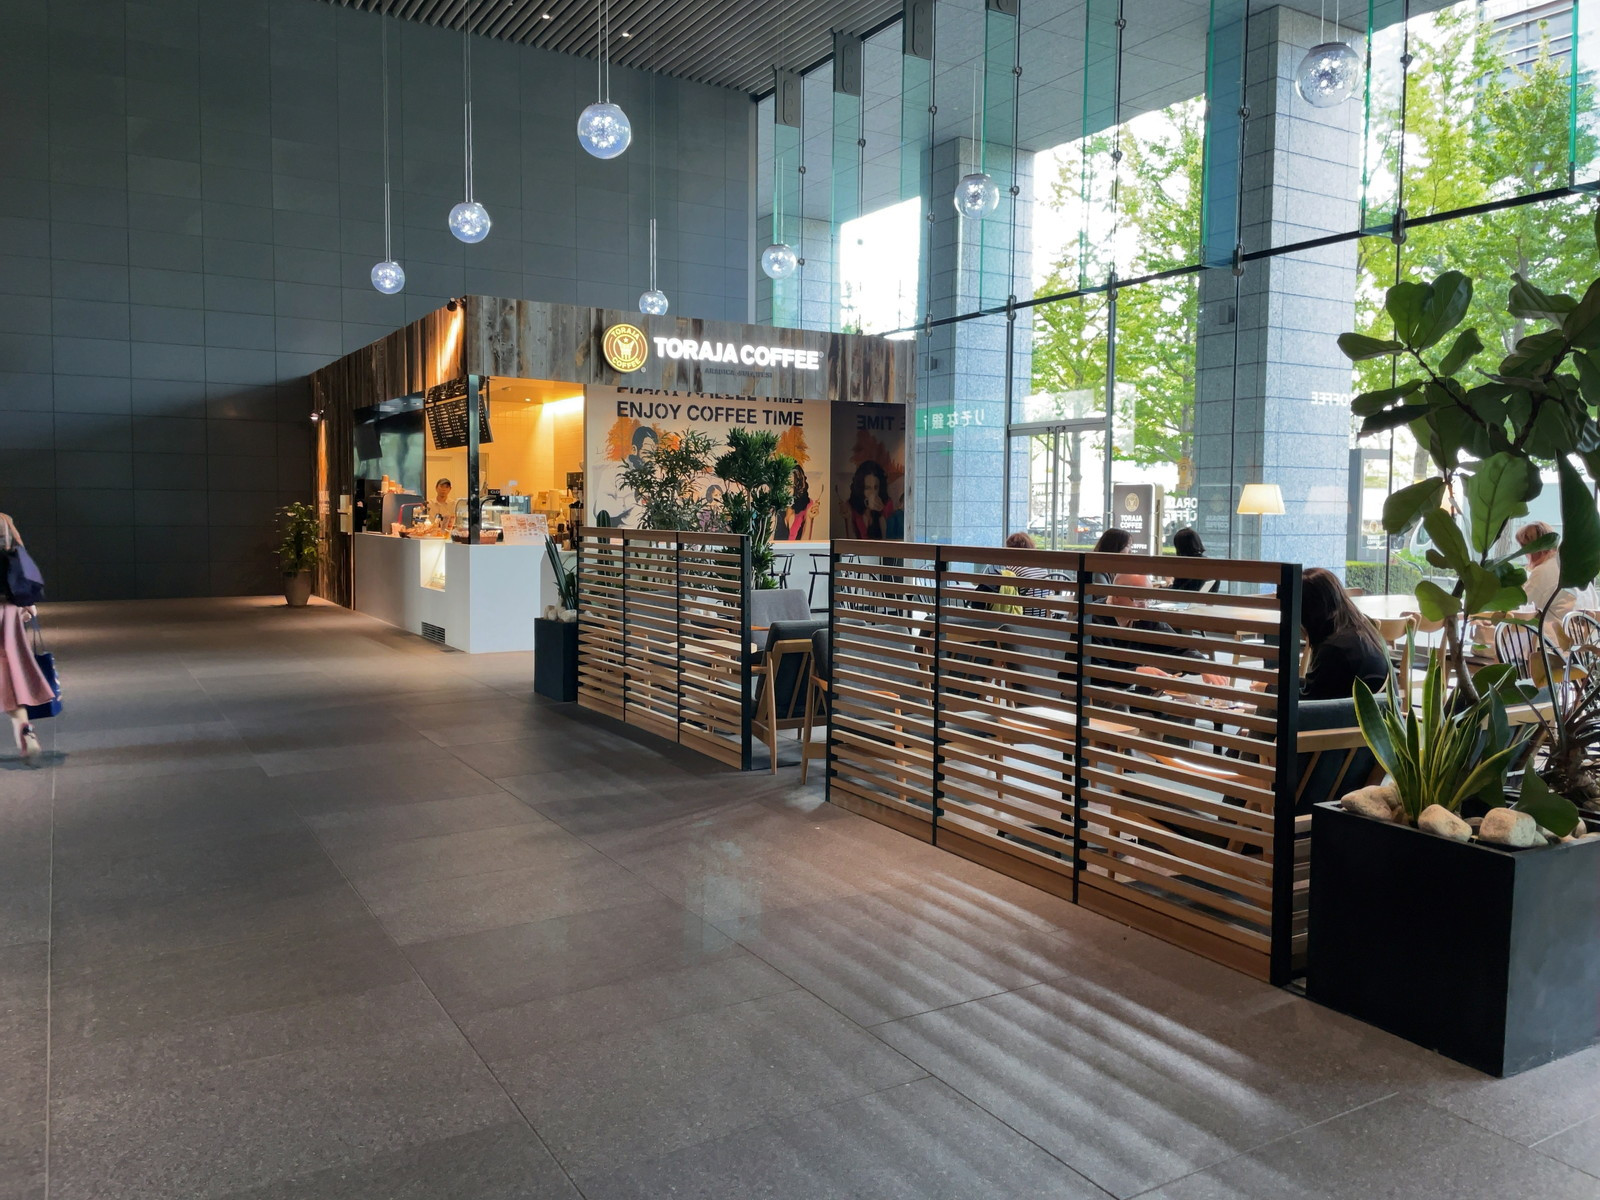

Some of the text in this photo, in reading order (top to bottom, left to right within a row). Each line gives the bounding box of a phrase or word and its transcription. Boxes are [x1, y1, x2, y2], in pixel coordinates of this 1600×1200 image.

[611, 327, 640, 340] TORAJA
[612, 356, 641, 369] COFFEE
[653, 336, 820, 370] TORAJA COFFEE
[616, 400, 804, 427] ENJOY COFFEE TIME
